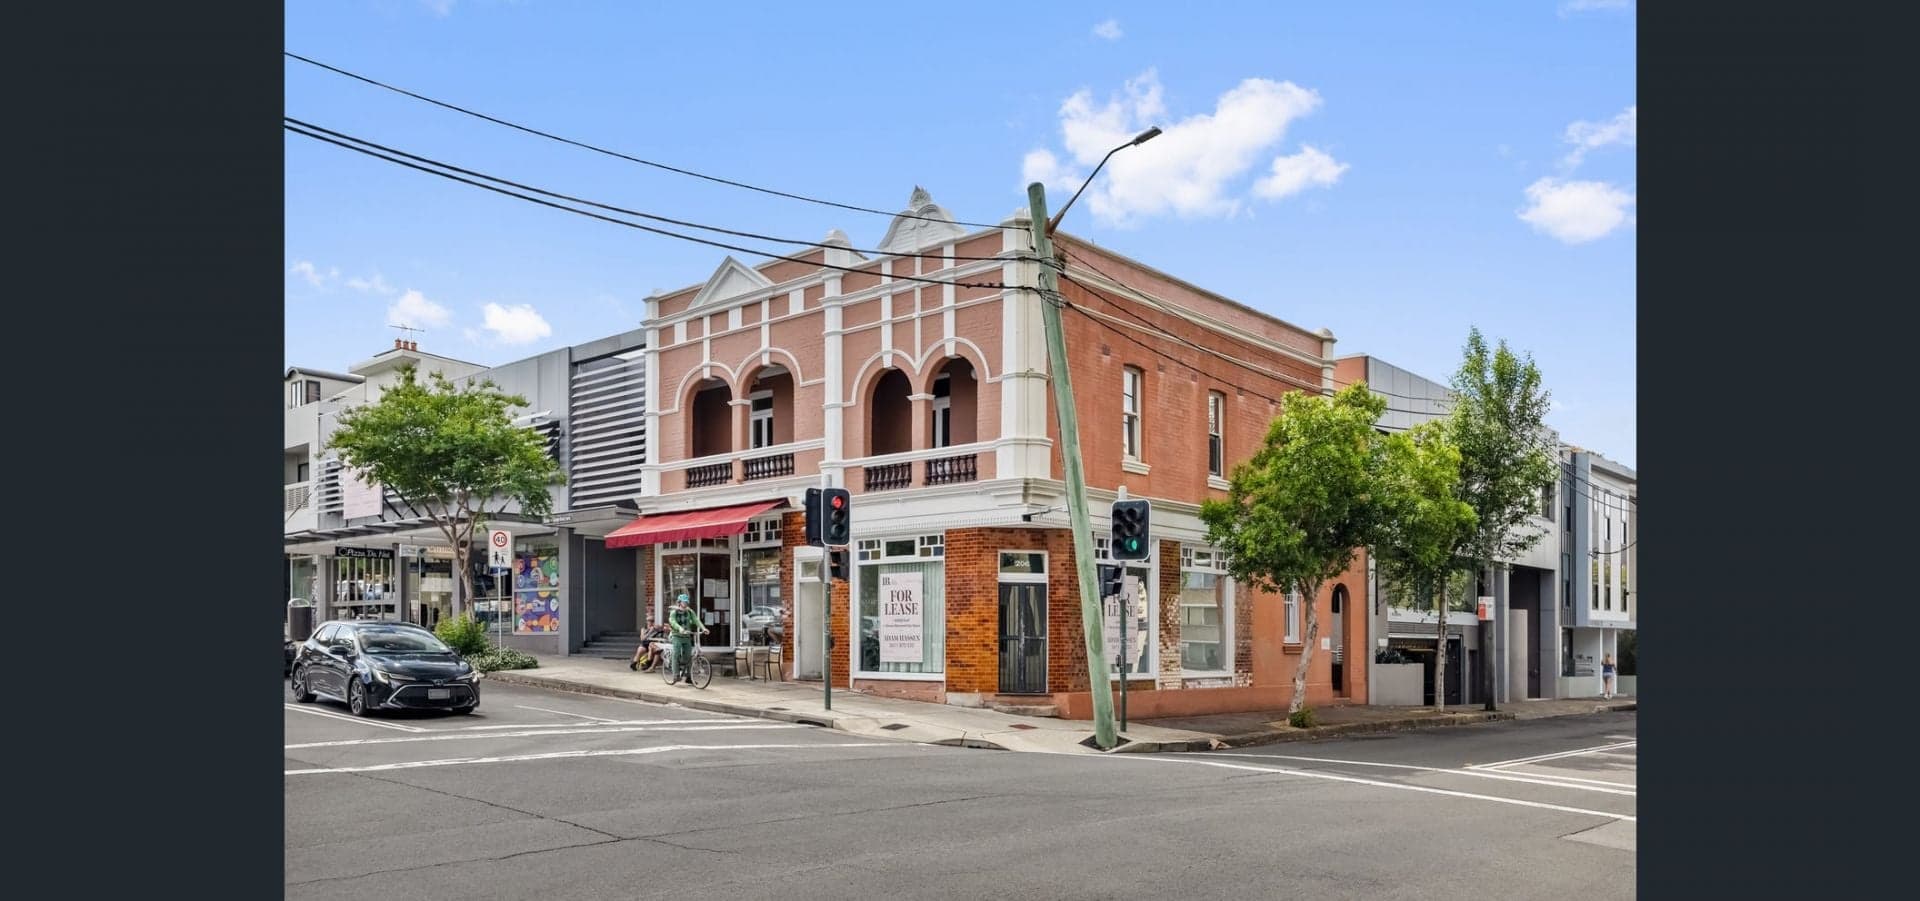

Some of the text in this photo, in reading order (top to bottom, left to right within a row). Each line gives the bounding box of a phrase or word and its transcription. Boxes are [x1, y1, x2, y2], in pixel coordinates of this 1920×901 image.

[890, 590, 912, 602] FOR
[884, 602, 919, 615] LEASE
[1107, 604, 1136, 616] LESE
